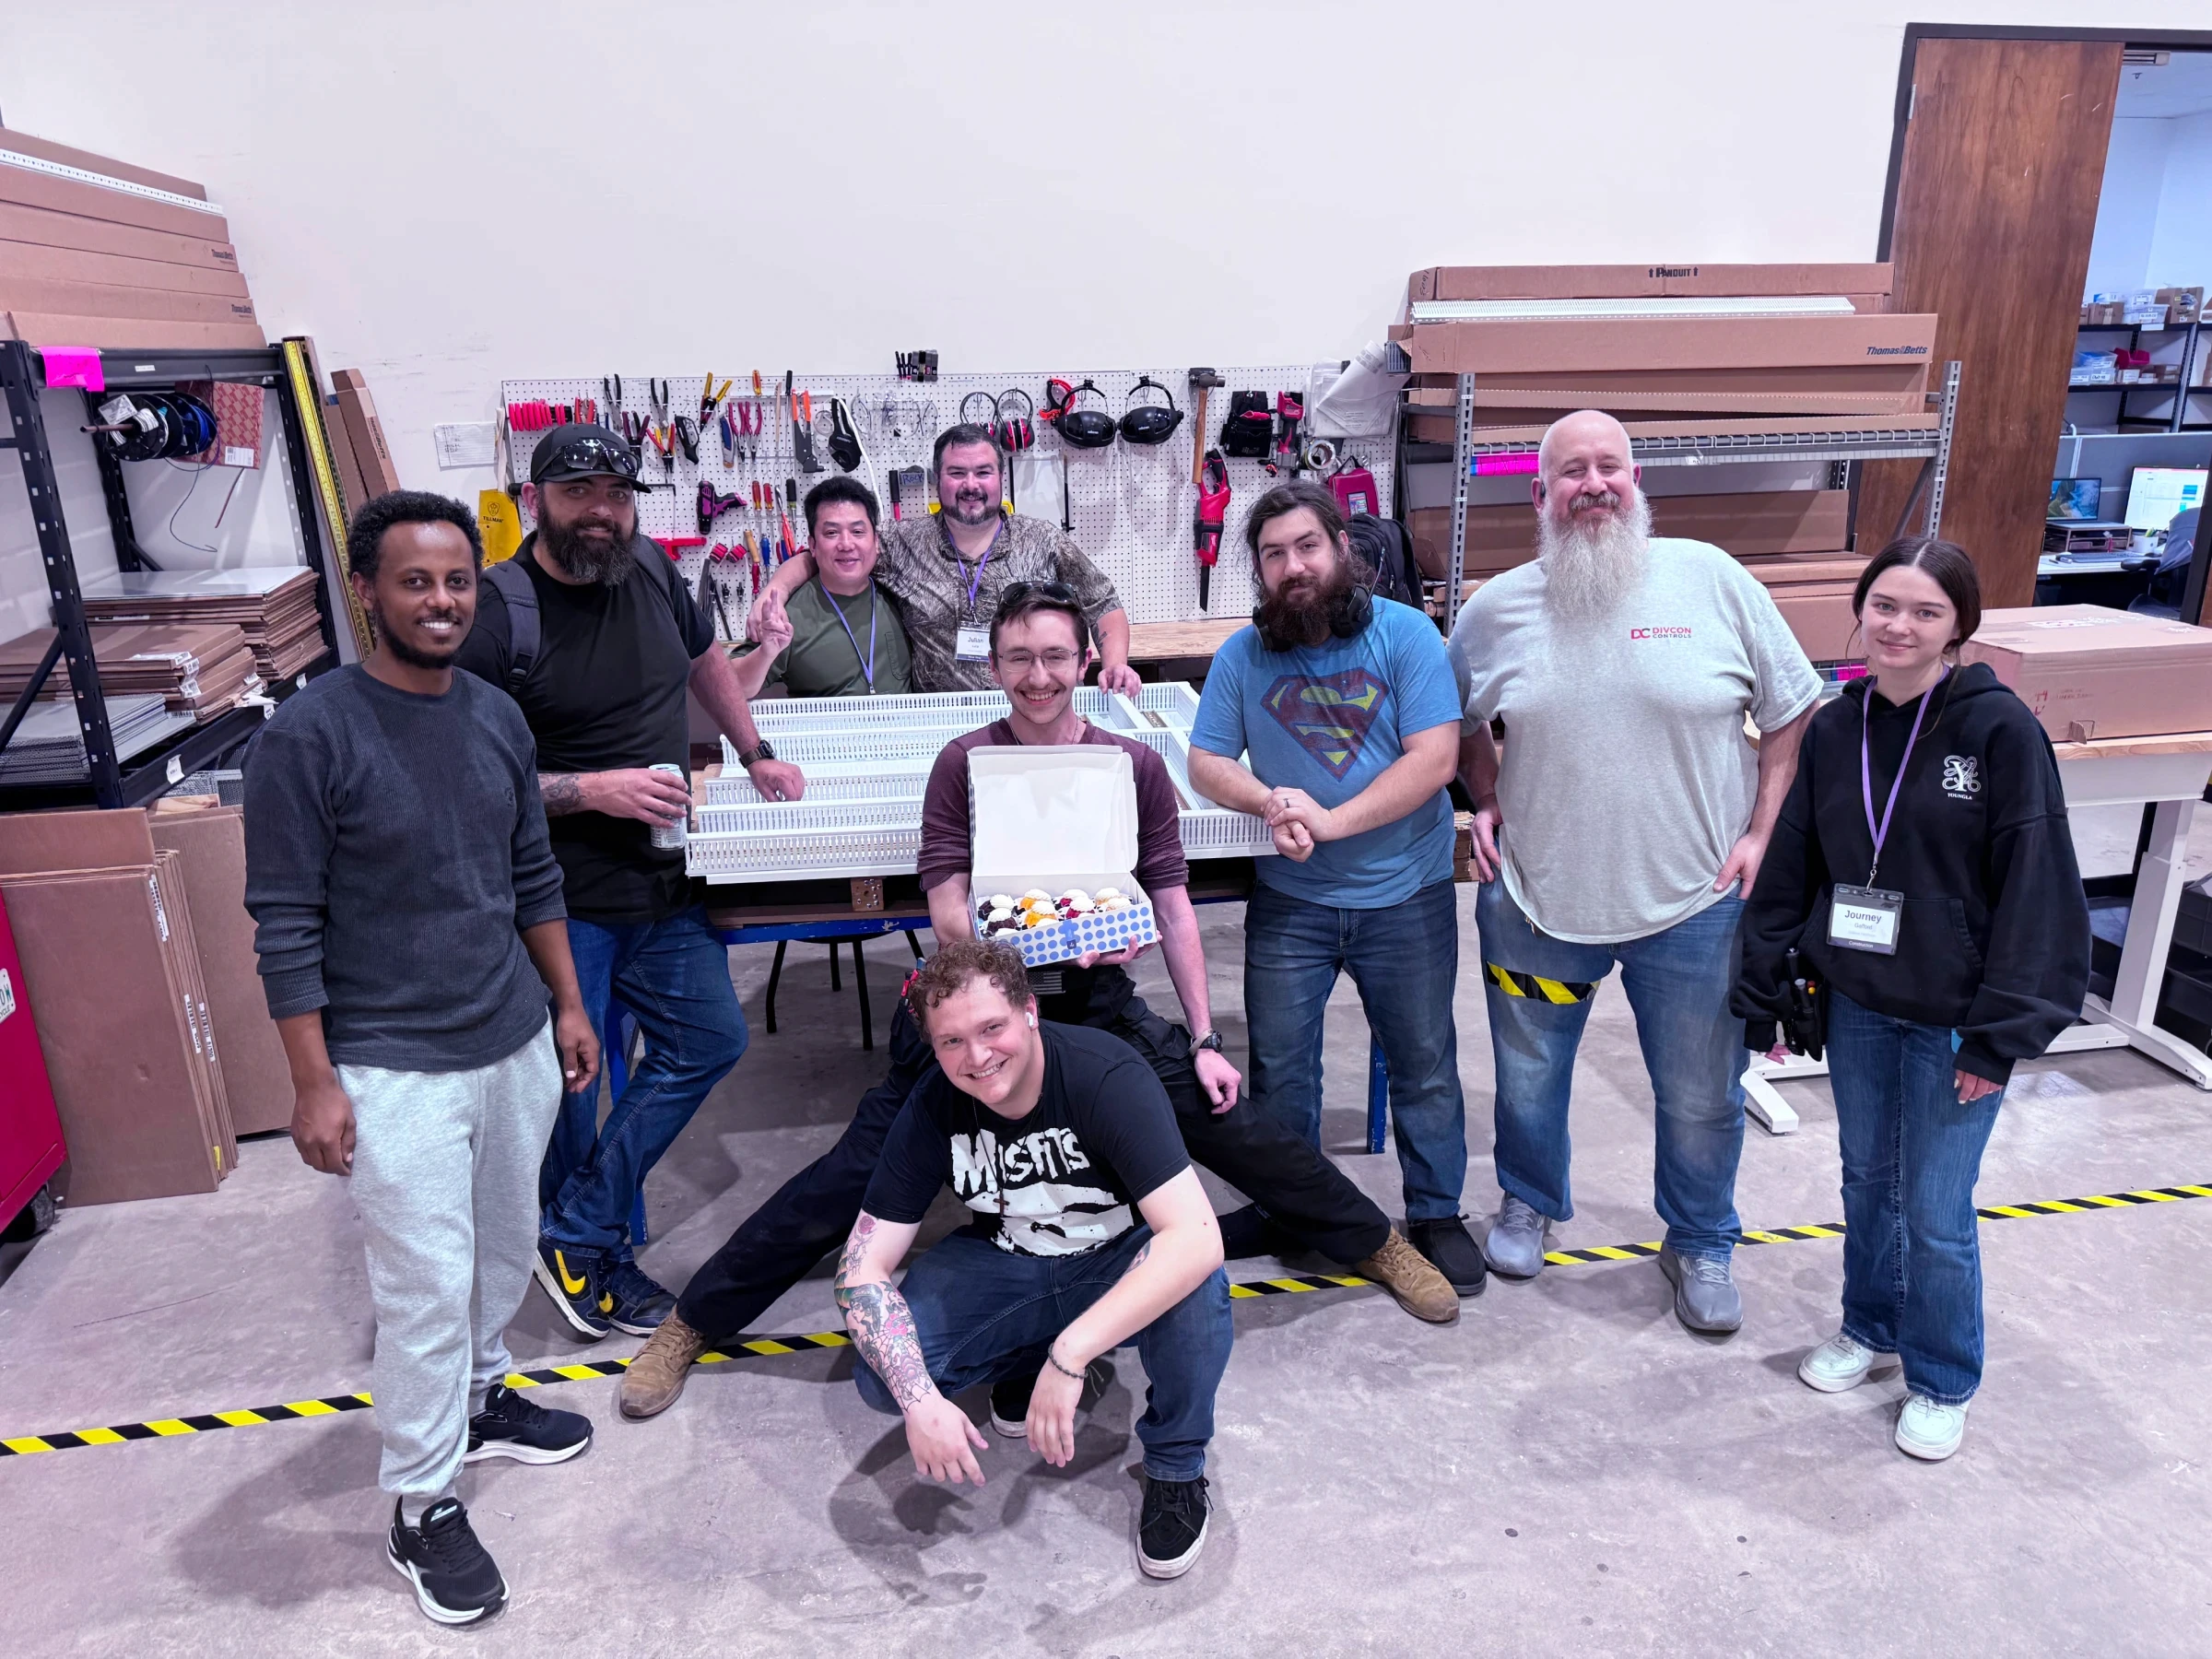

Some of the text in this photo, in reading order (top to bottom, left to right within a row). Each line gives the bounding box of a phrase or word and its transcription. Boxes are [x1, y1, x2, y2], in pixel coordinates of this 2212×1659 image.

[1655, 266, 1692, 278] PANDUIT
[1630, 628, 1652, 640] DC
[1947, 792, 1973, 801] YOUNGLA
[1844, 910, 1882, 924] Journey
